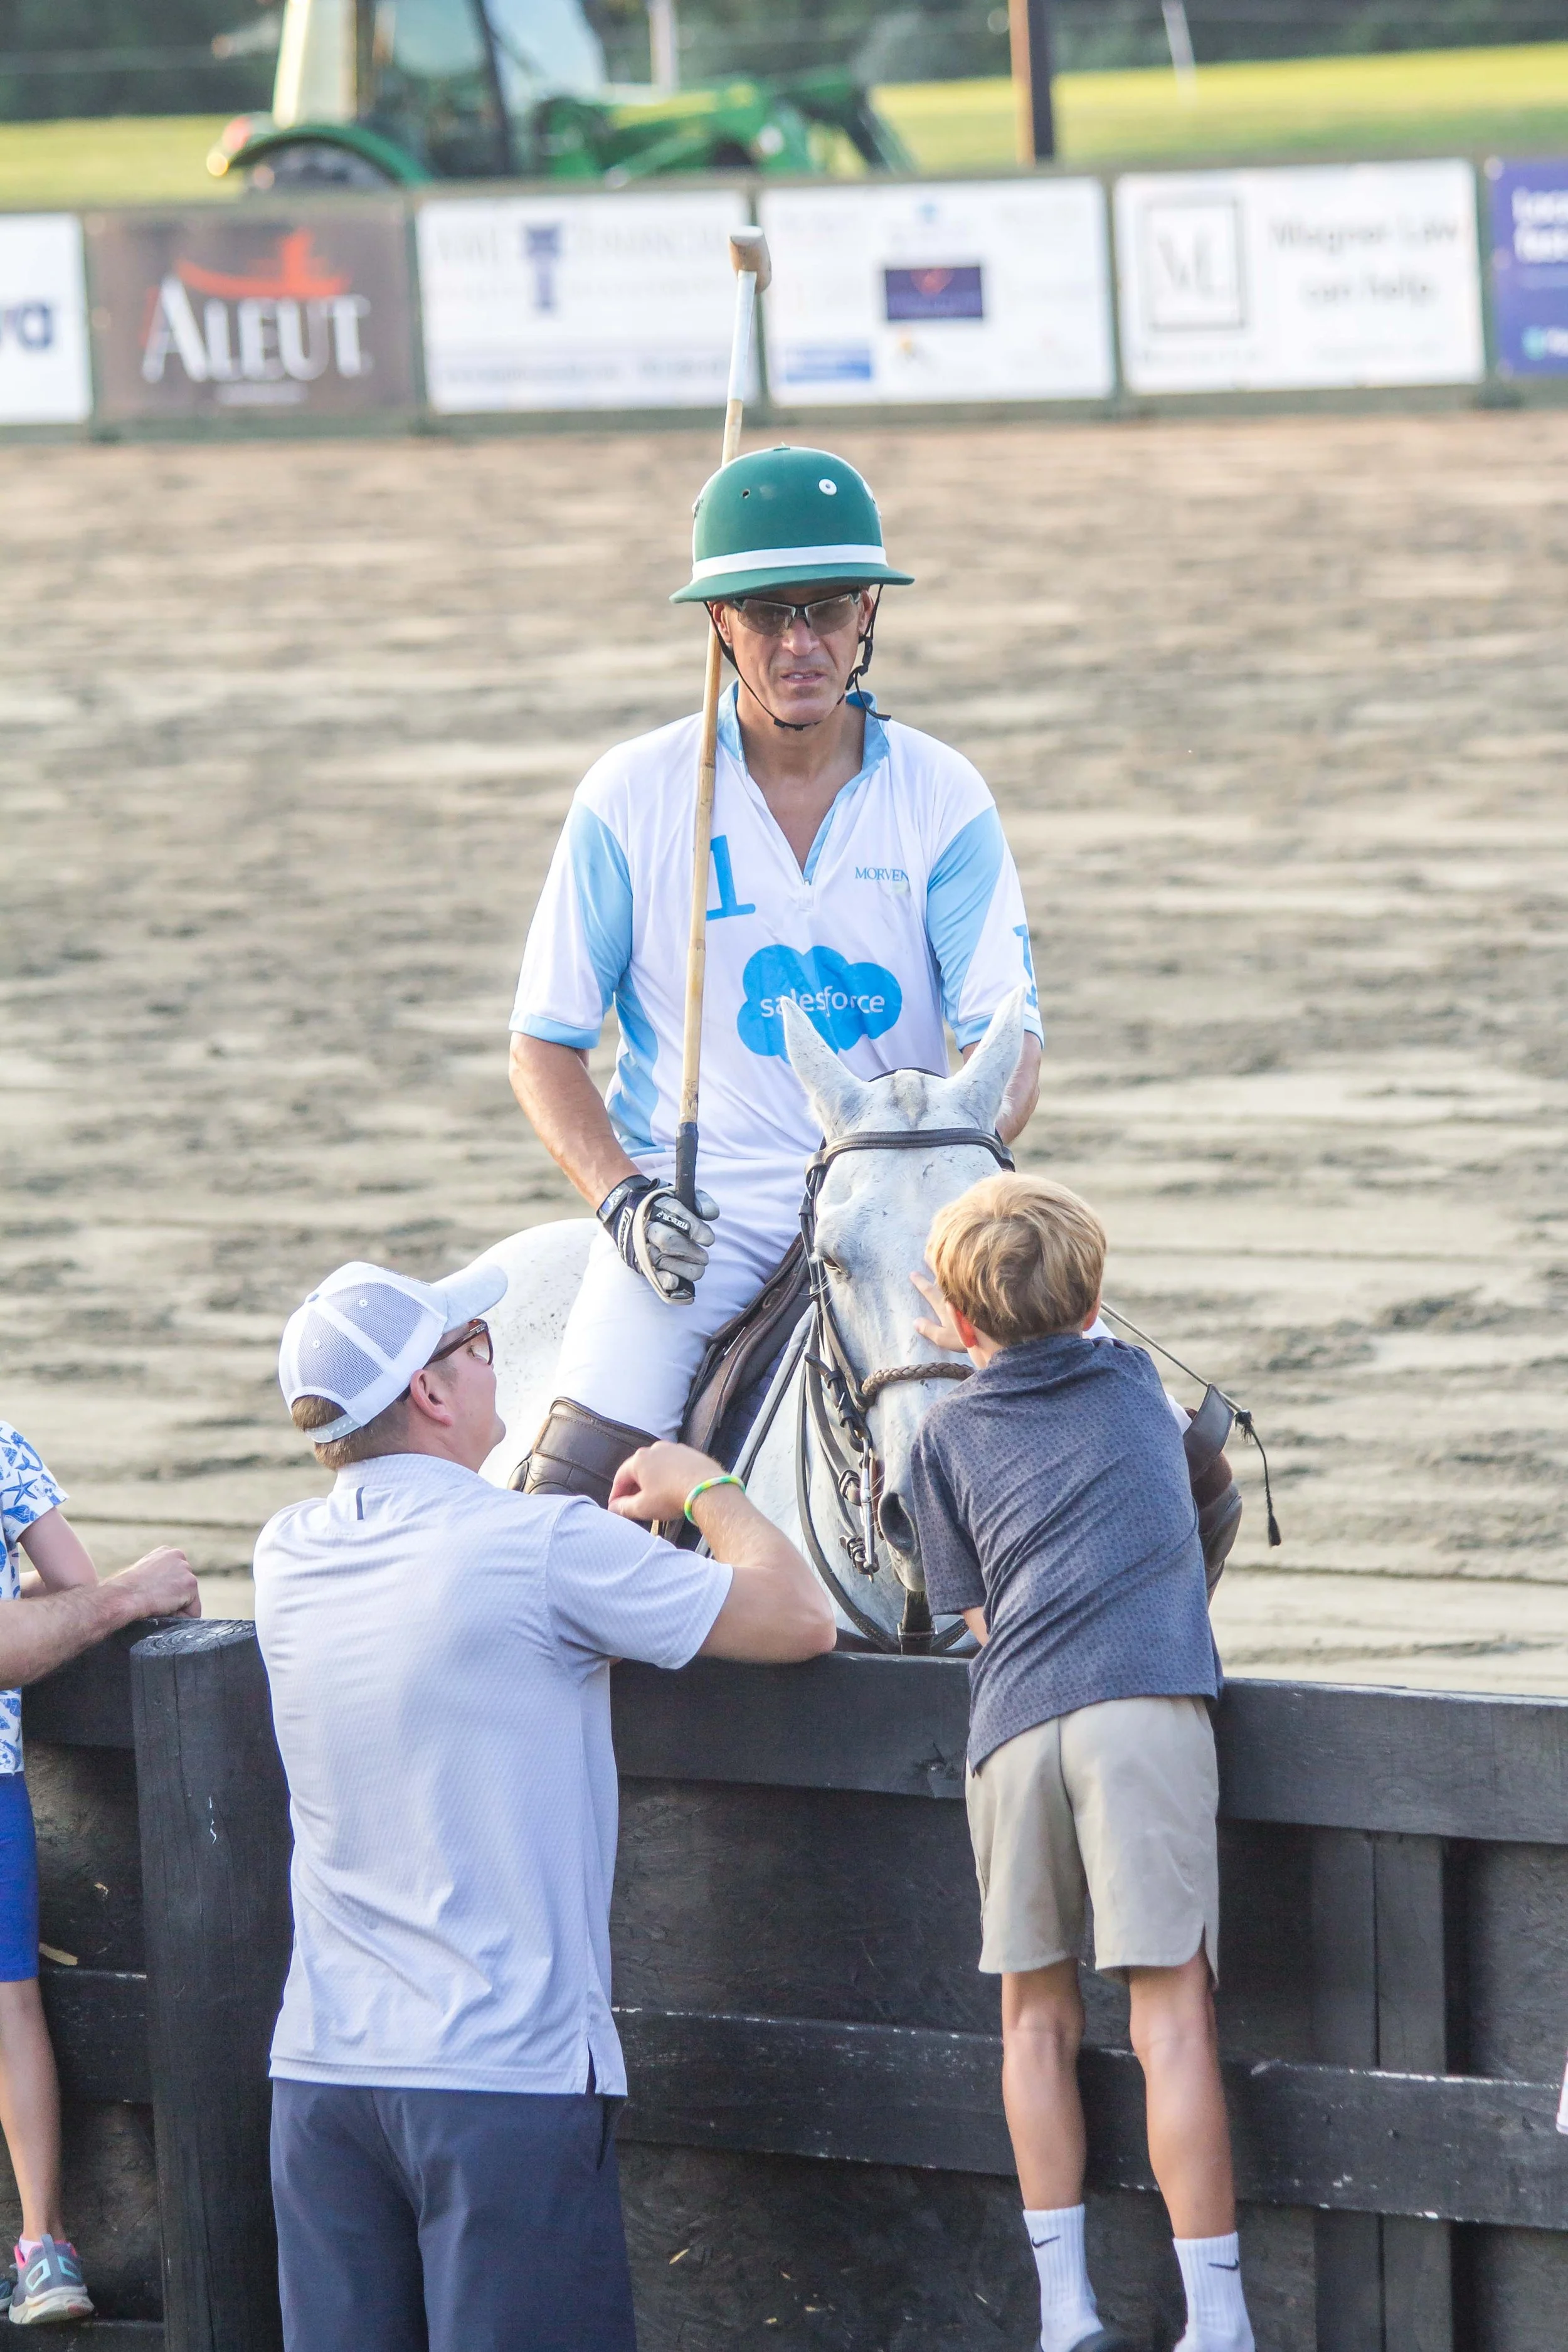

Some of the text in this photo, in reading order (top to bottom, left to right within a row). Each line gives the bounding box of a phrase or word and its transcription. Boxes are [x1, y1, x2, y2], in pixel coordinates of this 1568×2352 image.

[142, 275, 370, 383] ALEUT
[706, 835, 756, 921] 1
[855, 866, 909, 882] MORVEN
